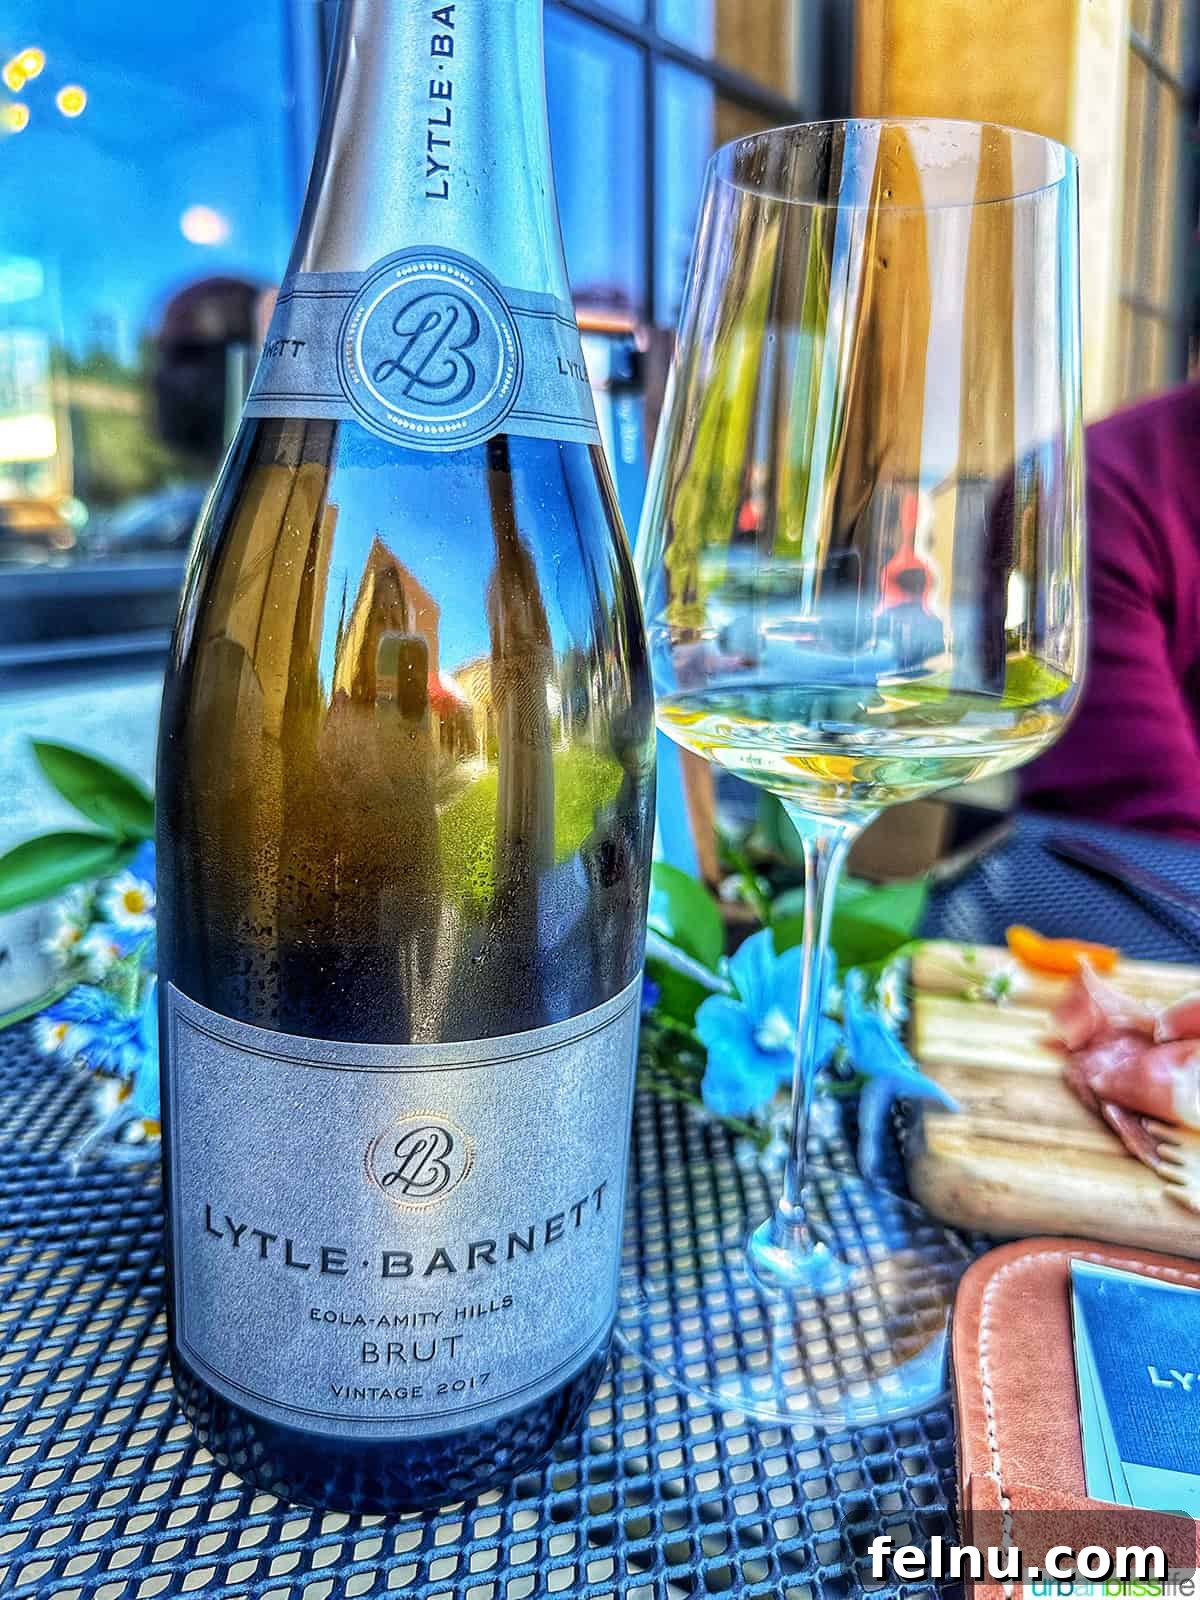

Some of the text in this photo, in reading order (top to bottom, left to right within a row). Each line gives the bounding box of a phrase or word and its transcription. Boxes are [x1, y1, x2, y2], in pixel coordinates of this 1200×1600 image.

[310, 1295, 514, 1329] EOLA-AMITY HILLS
[361, 1335, 464, 1365] BRUT
[331, 1373, 491, 1400] VINTAGE 2017
[1147, 1365, 1200, 1392] LY
